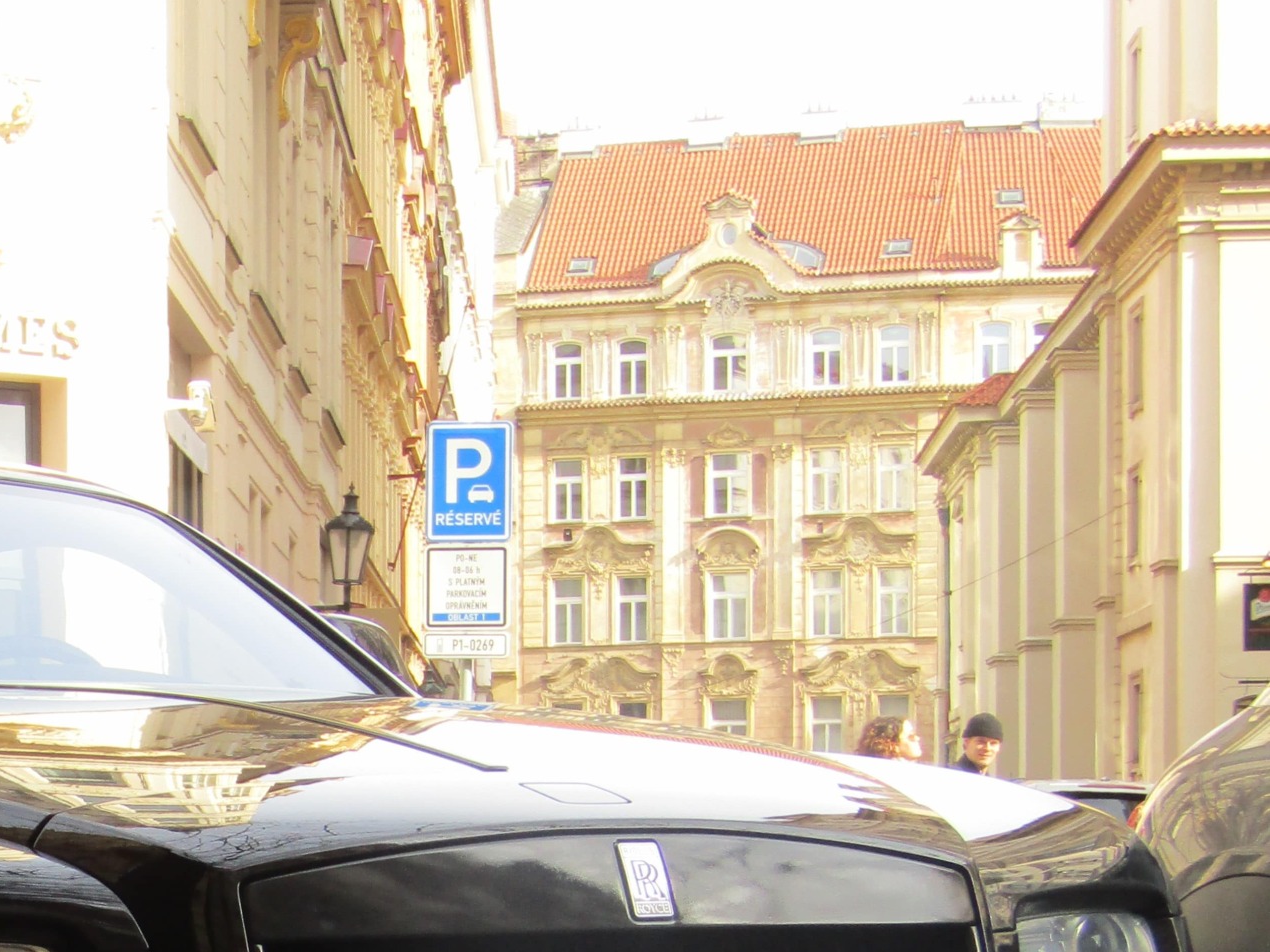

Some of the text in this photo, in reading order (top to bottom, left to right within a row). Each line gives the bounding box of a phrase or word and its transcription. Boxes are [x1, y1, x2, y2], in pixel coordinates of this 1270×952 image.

[445, 438, 493, 504] P
[435, 509, 501, 527] RÉSERVÉ
[455, 553, 478, 562] PO-NE
[448, 576, 486, 586] S PLATNÝM
[446, 588, 487, 598] PARKOVACÍM
[445, 600, 488, 610] OPRÁVNĚNÍM
[447, 613, 478, 621] OBLAST
[452, 639, 495, 652] P1-0269
